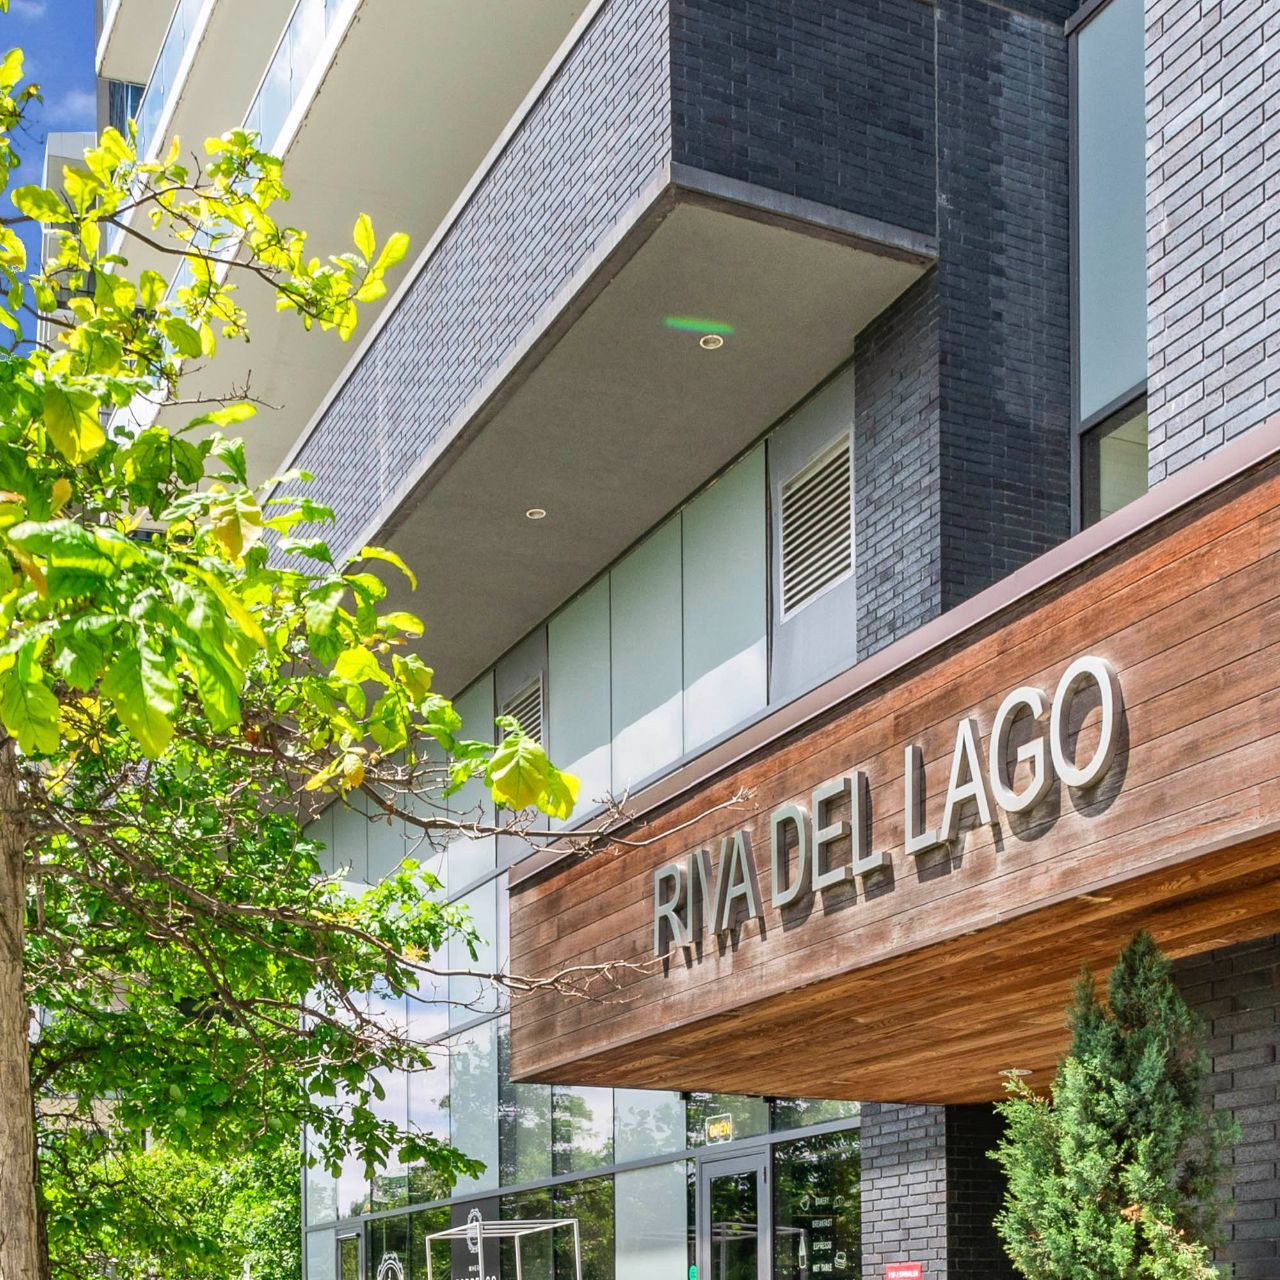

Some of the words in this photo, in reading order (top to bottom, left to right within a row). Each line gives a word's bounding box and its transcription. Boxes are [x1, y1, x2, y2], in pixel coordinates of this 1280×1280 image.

[653, 829, 762, 956] RIVA
[770, 770, 891, 909] DEL
[904, 655, 1120, 856] LAGO
